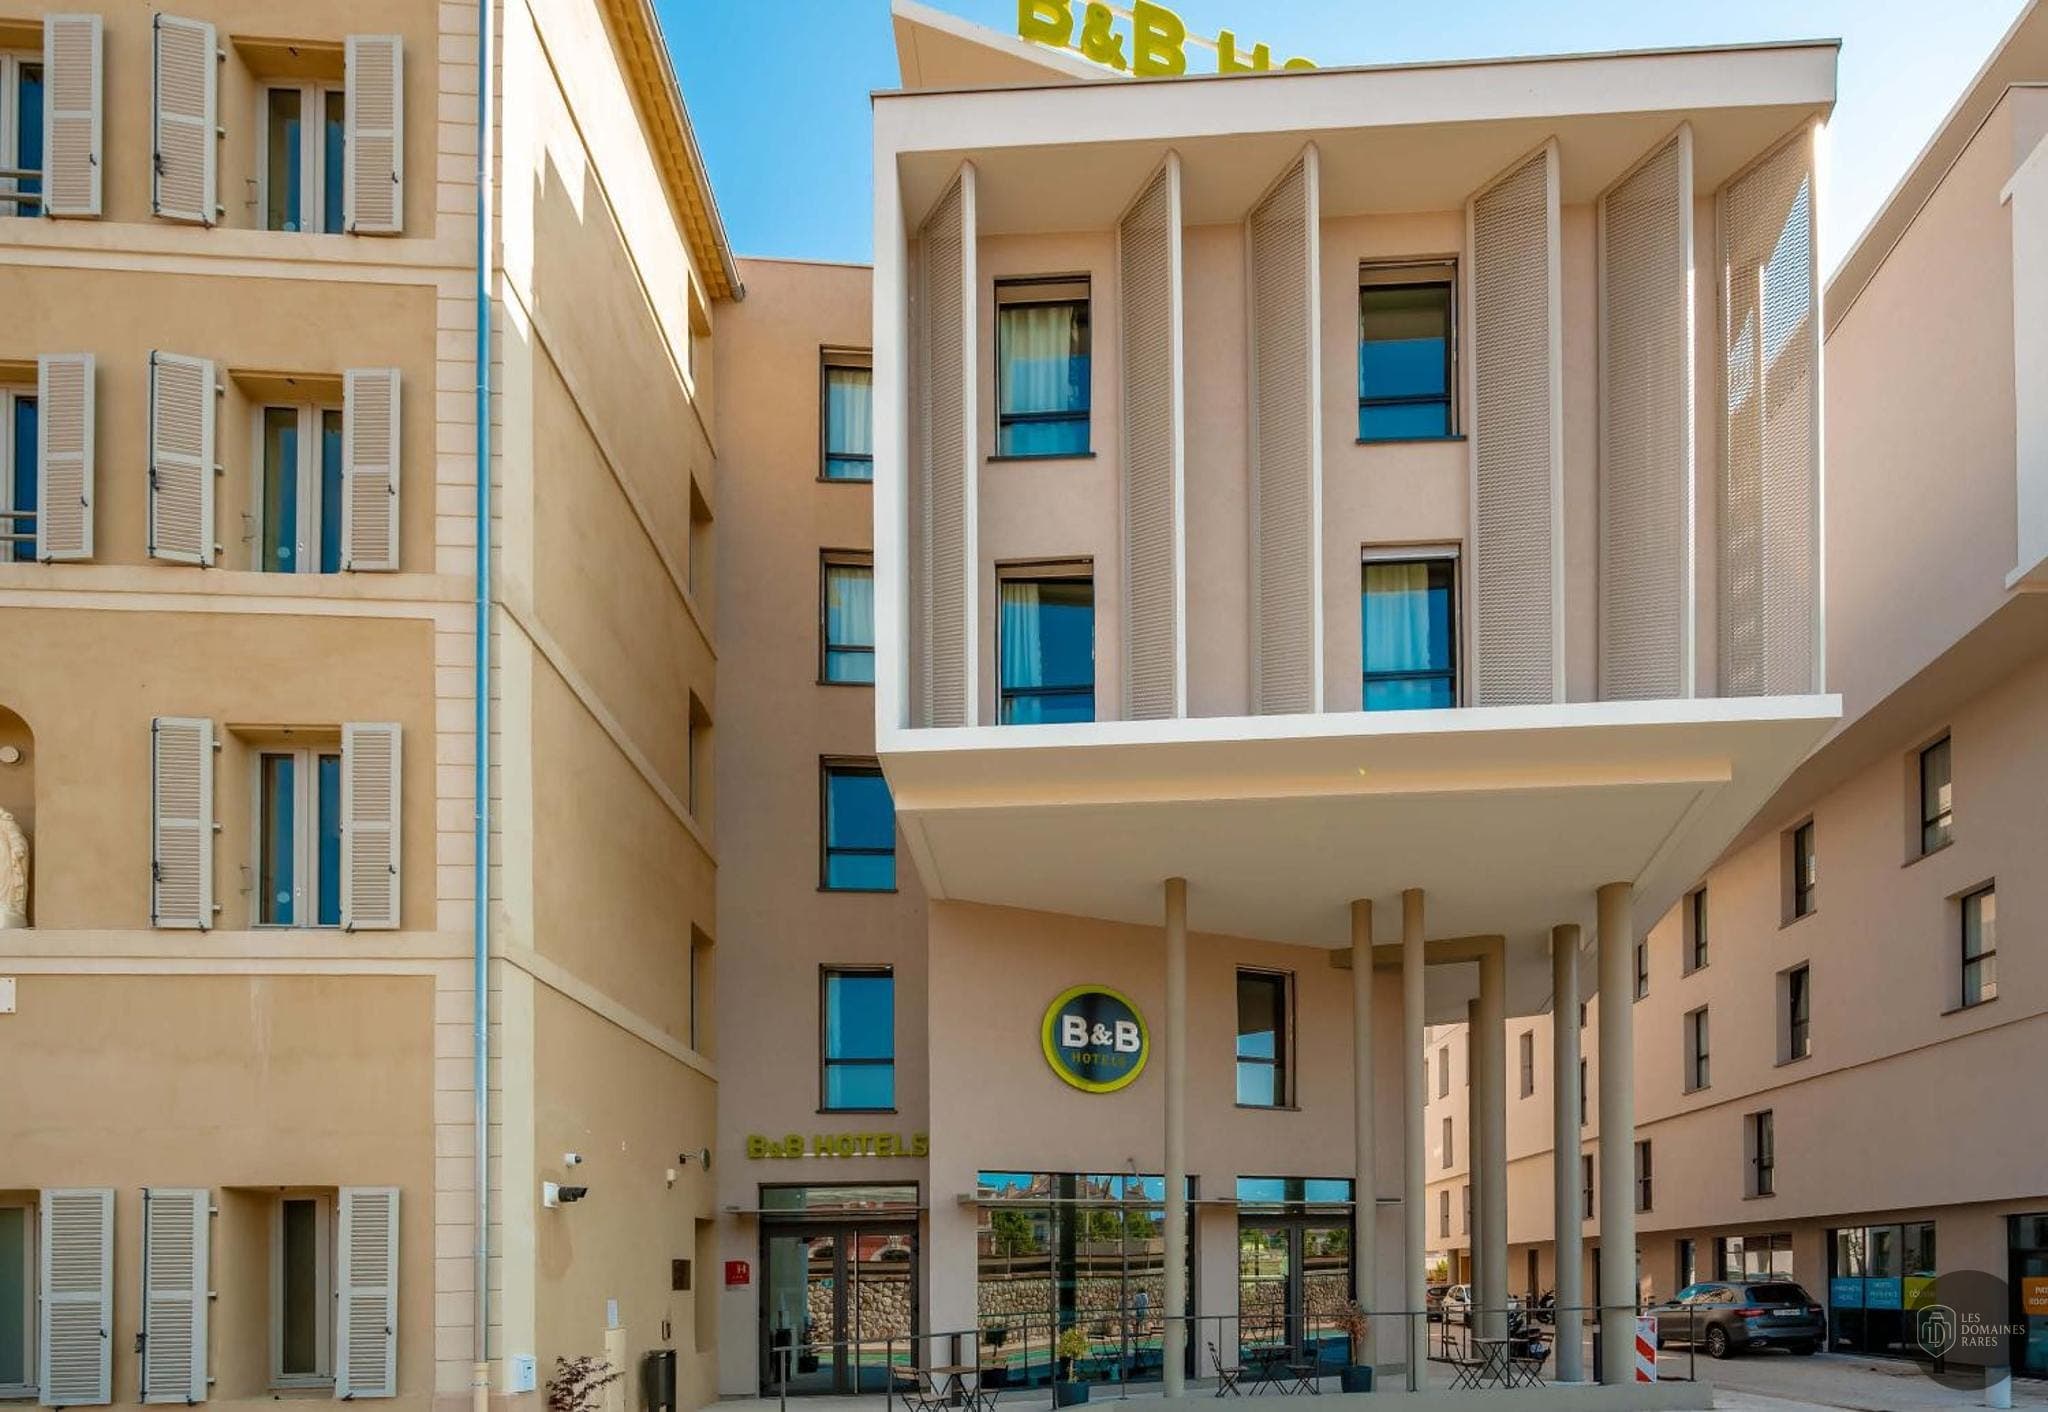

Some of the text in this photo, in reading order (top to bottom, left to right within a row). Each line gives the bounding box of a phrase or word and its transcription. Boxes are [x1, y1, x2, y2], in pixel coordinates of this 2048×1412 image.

[1018, 0, 1187, 77] B&B
[1062, 1015, 1140, 1052] B&B
[748, 1133, 929, 1158] B&B HOTELS
